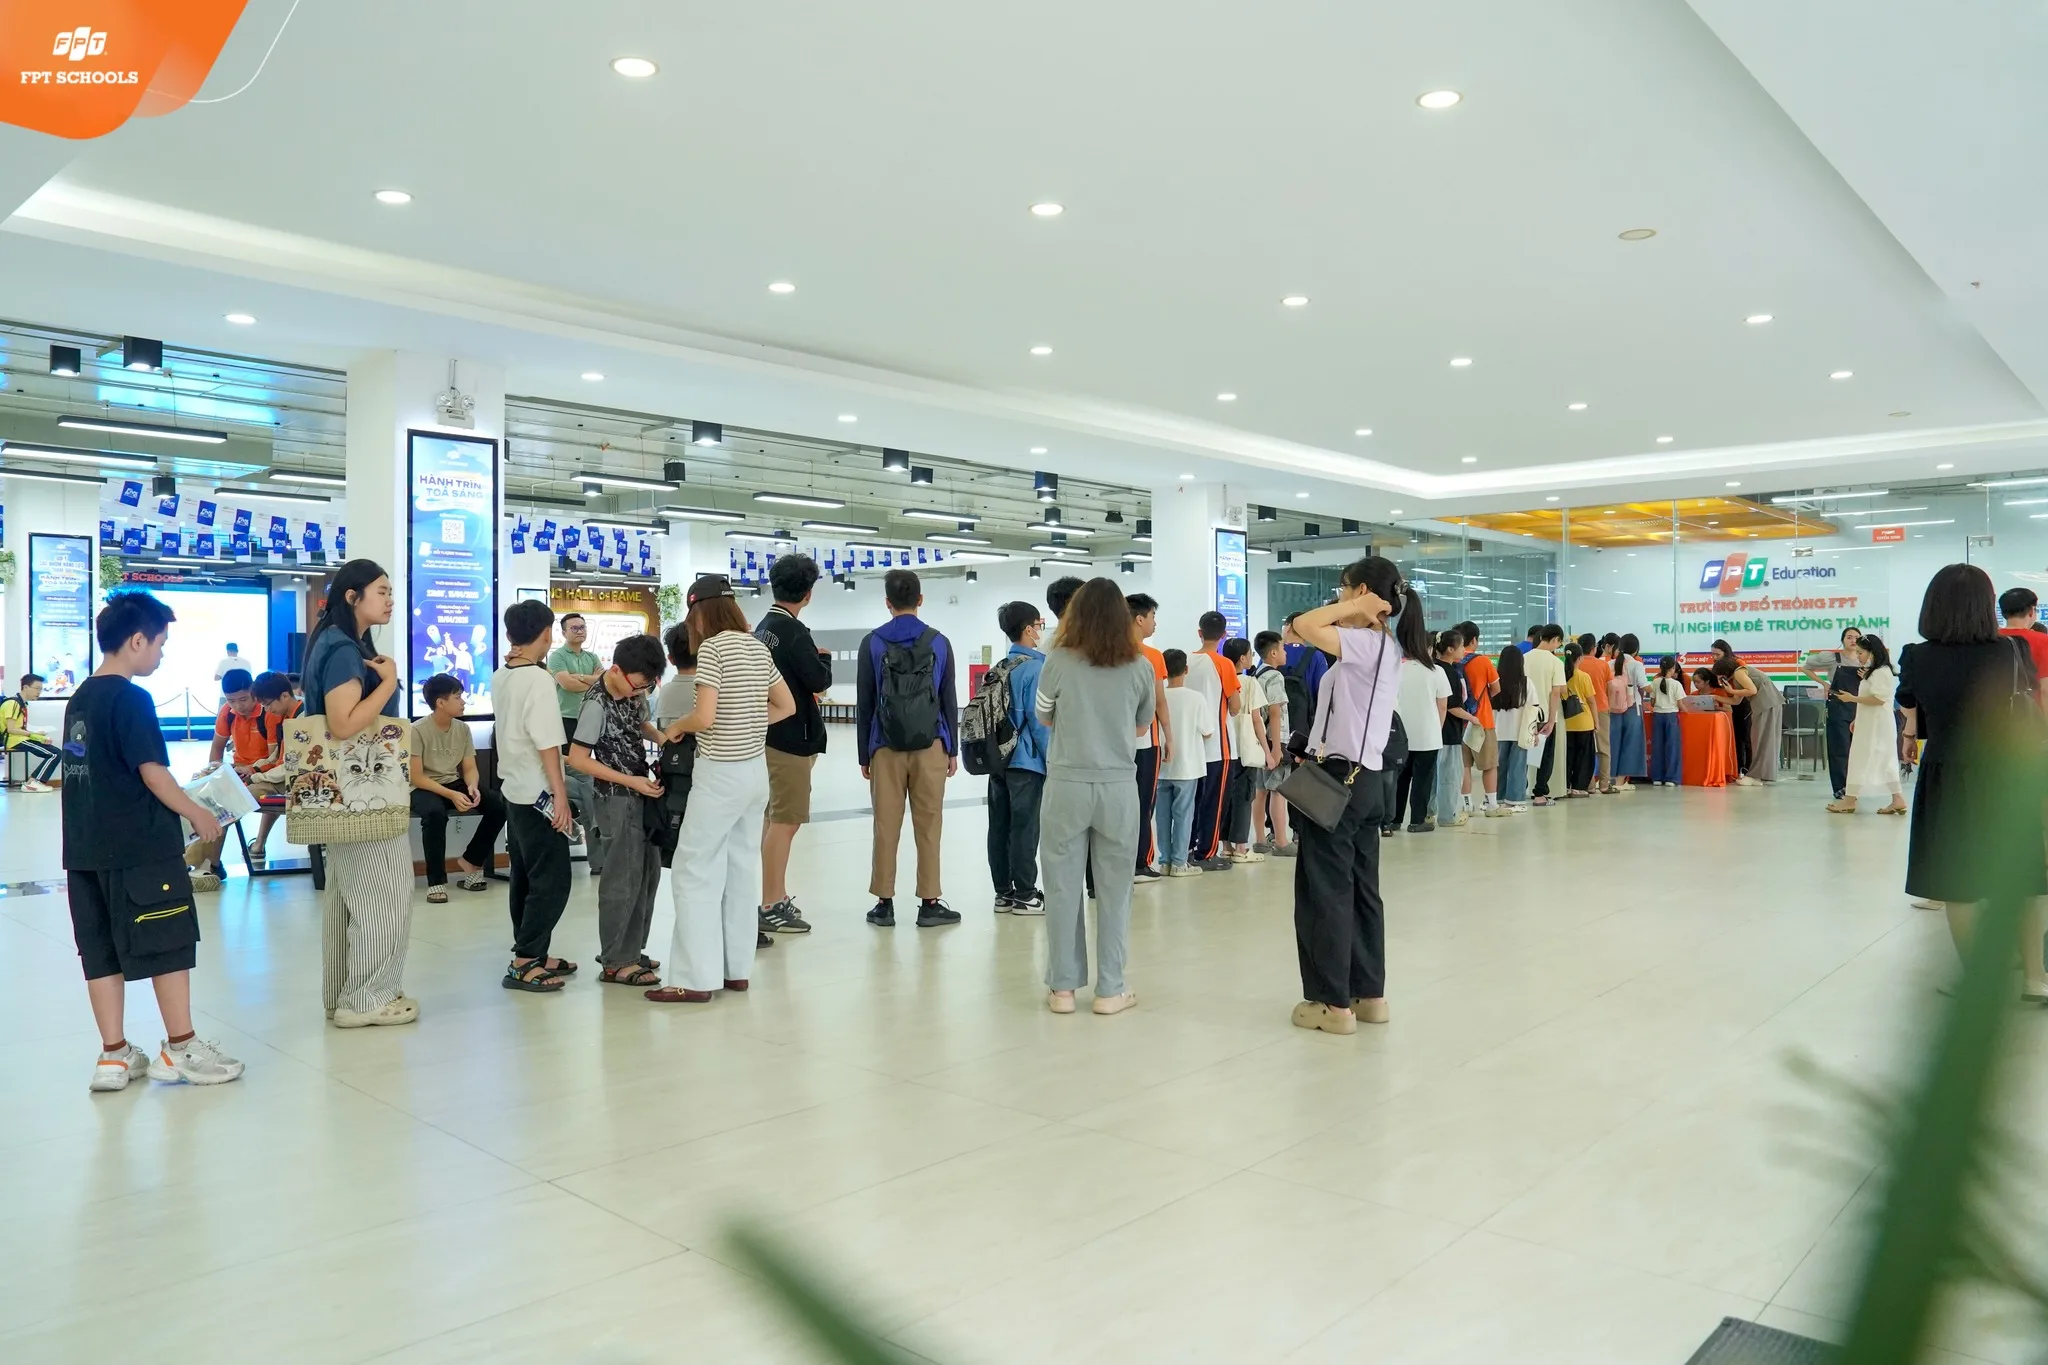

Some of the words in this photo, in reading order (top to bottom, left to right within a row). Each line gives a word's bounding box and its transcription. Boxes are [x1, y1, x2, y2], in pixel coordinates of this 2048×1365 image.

[455, 479, 485, 490] TRÌN
[132, 572, 184, 583] SCHOOLS
[1701, 559, 1766, 589] FPT
[1772, 565, 1836, 580] Education
[565, 588, 594, 602] HALL
[610, 590, 643, 603] FAME
[1771, 596, 1826, 610] THÔNG
[1828, 597, 1858, 608] FPT
[1836, 615, 1890, 629] THÀNH
